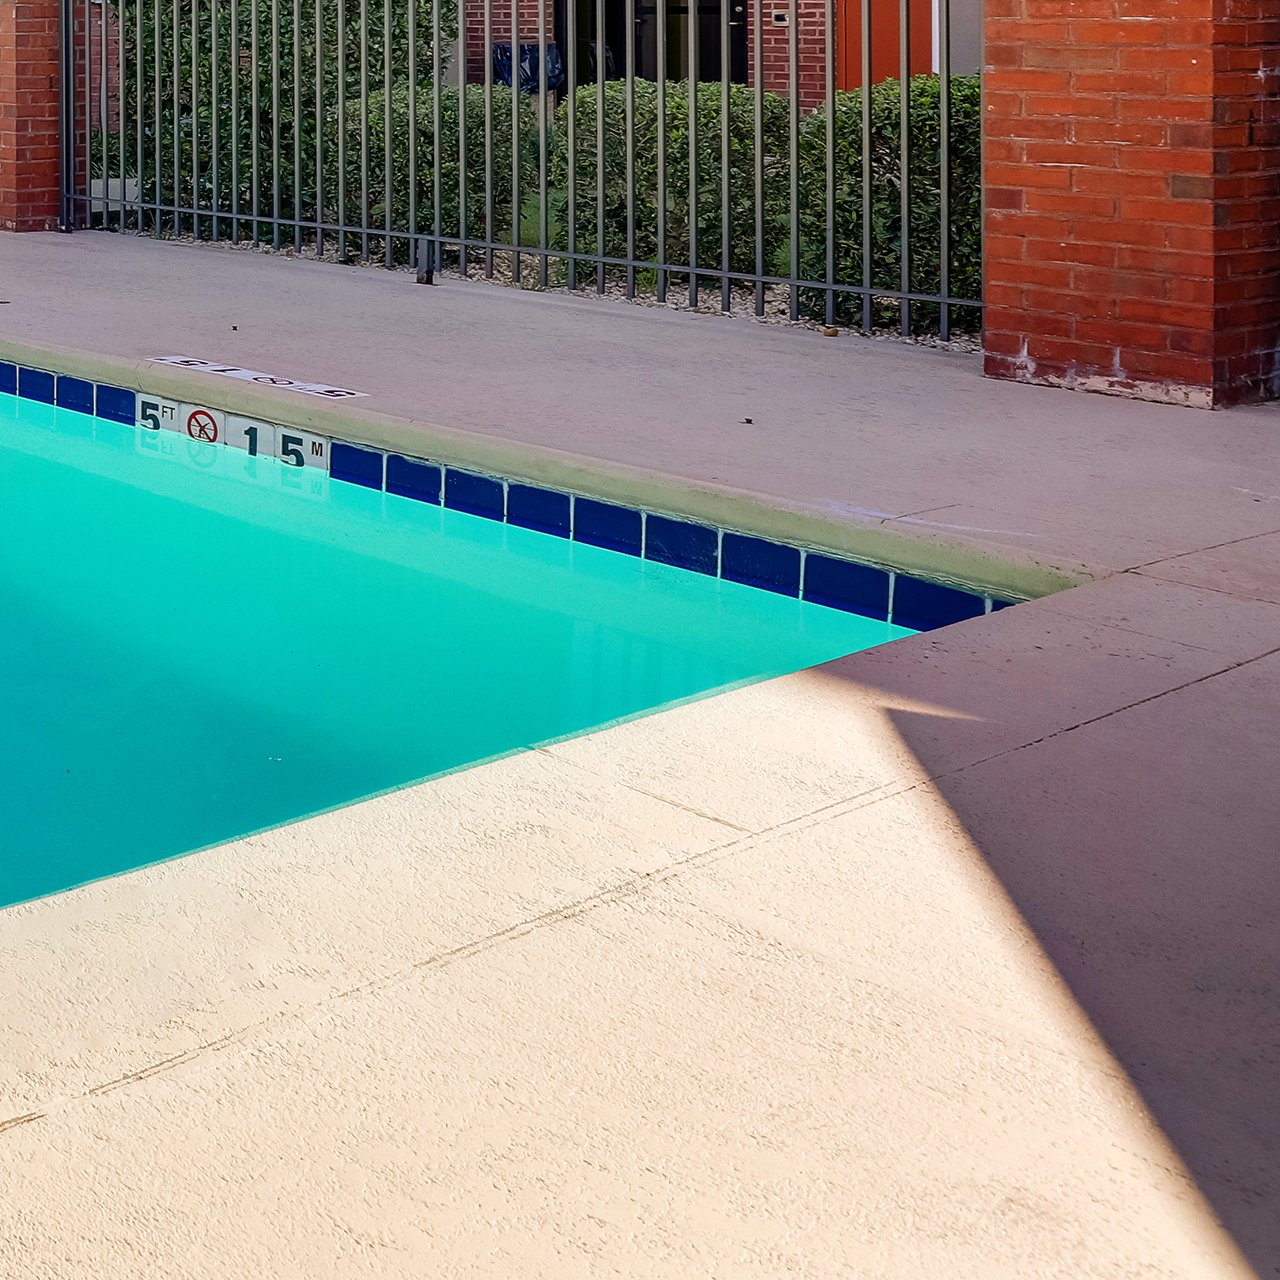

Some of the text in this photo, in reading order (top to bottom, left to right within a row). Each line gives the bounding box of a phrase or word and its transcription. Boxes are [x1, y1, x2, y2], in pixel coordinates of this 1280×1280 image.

[140, 400, 161, 430] 5
[161, 405, 176, 420] FT
[311, 441, 323, 457] M
